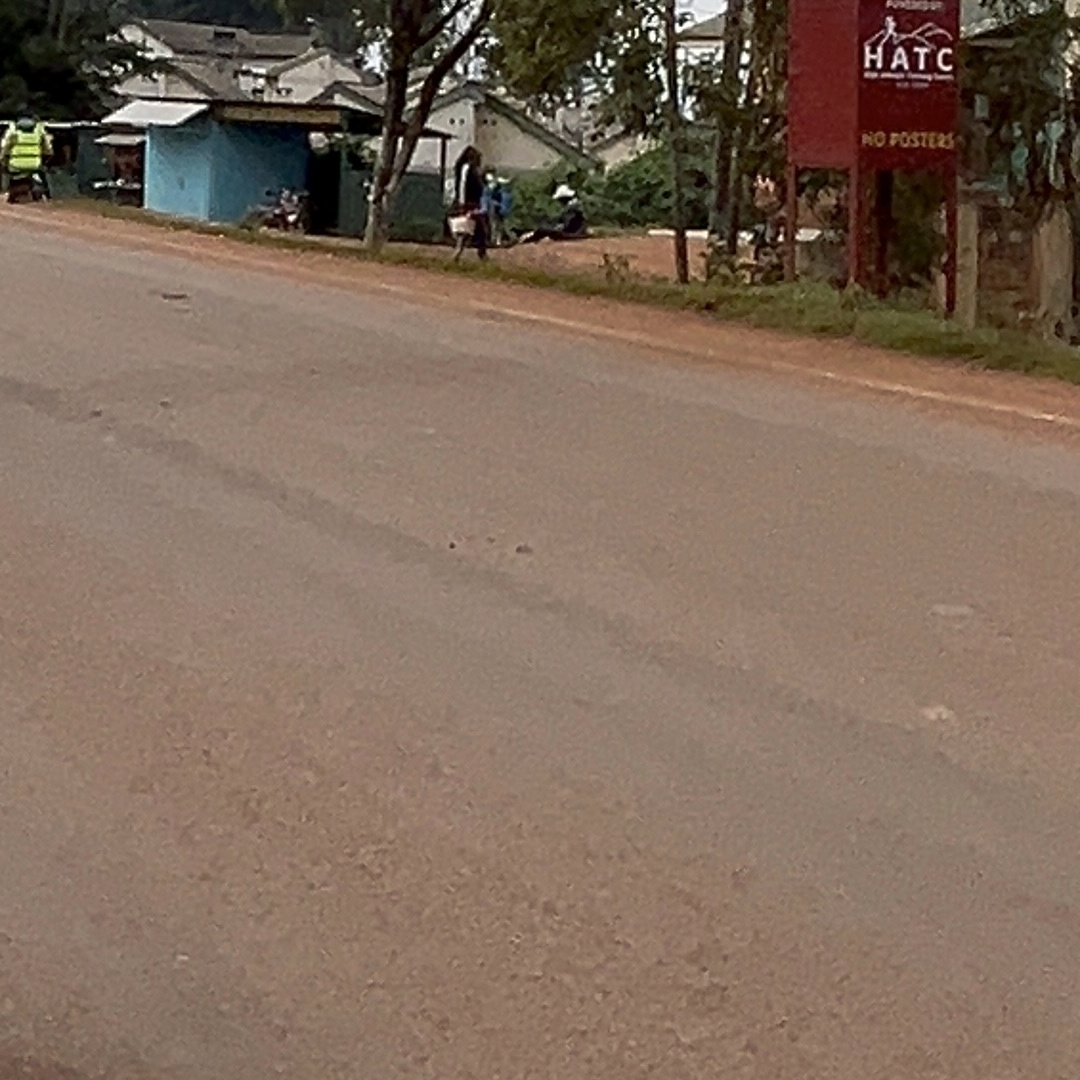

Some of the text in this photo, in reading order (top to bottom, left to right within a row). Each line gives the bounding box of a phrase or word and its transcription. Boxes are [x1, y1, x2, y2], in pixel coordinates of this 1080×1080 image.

[863, 45, 954, 71] HATC
[861, 131, 955, 150] NO POSTERS
